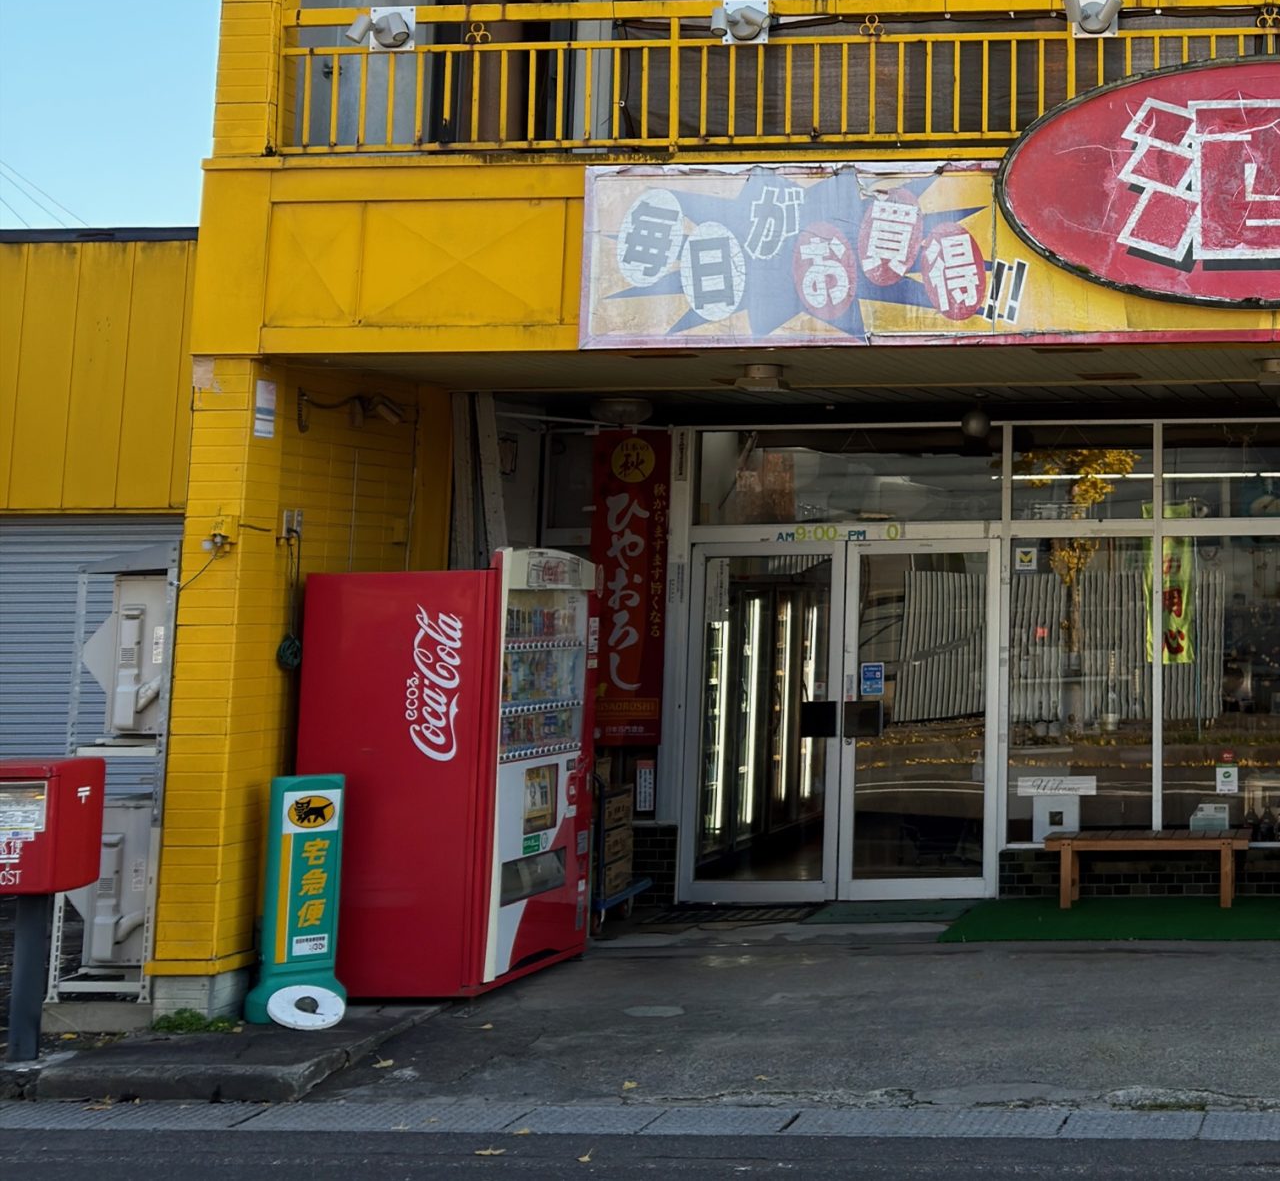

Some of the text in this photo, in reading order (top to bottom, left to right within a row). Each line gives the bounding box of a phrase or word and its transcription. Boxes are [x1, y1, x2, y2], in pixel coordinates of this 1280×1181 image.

[619, 452, 646, 478] 秋
[605, 492, 650, 691] ひやおろし
[410, 603, 463, 762] Coca-Cola
[298, 838, 330, 928] 宅急便
